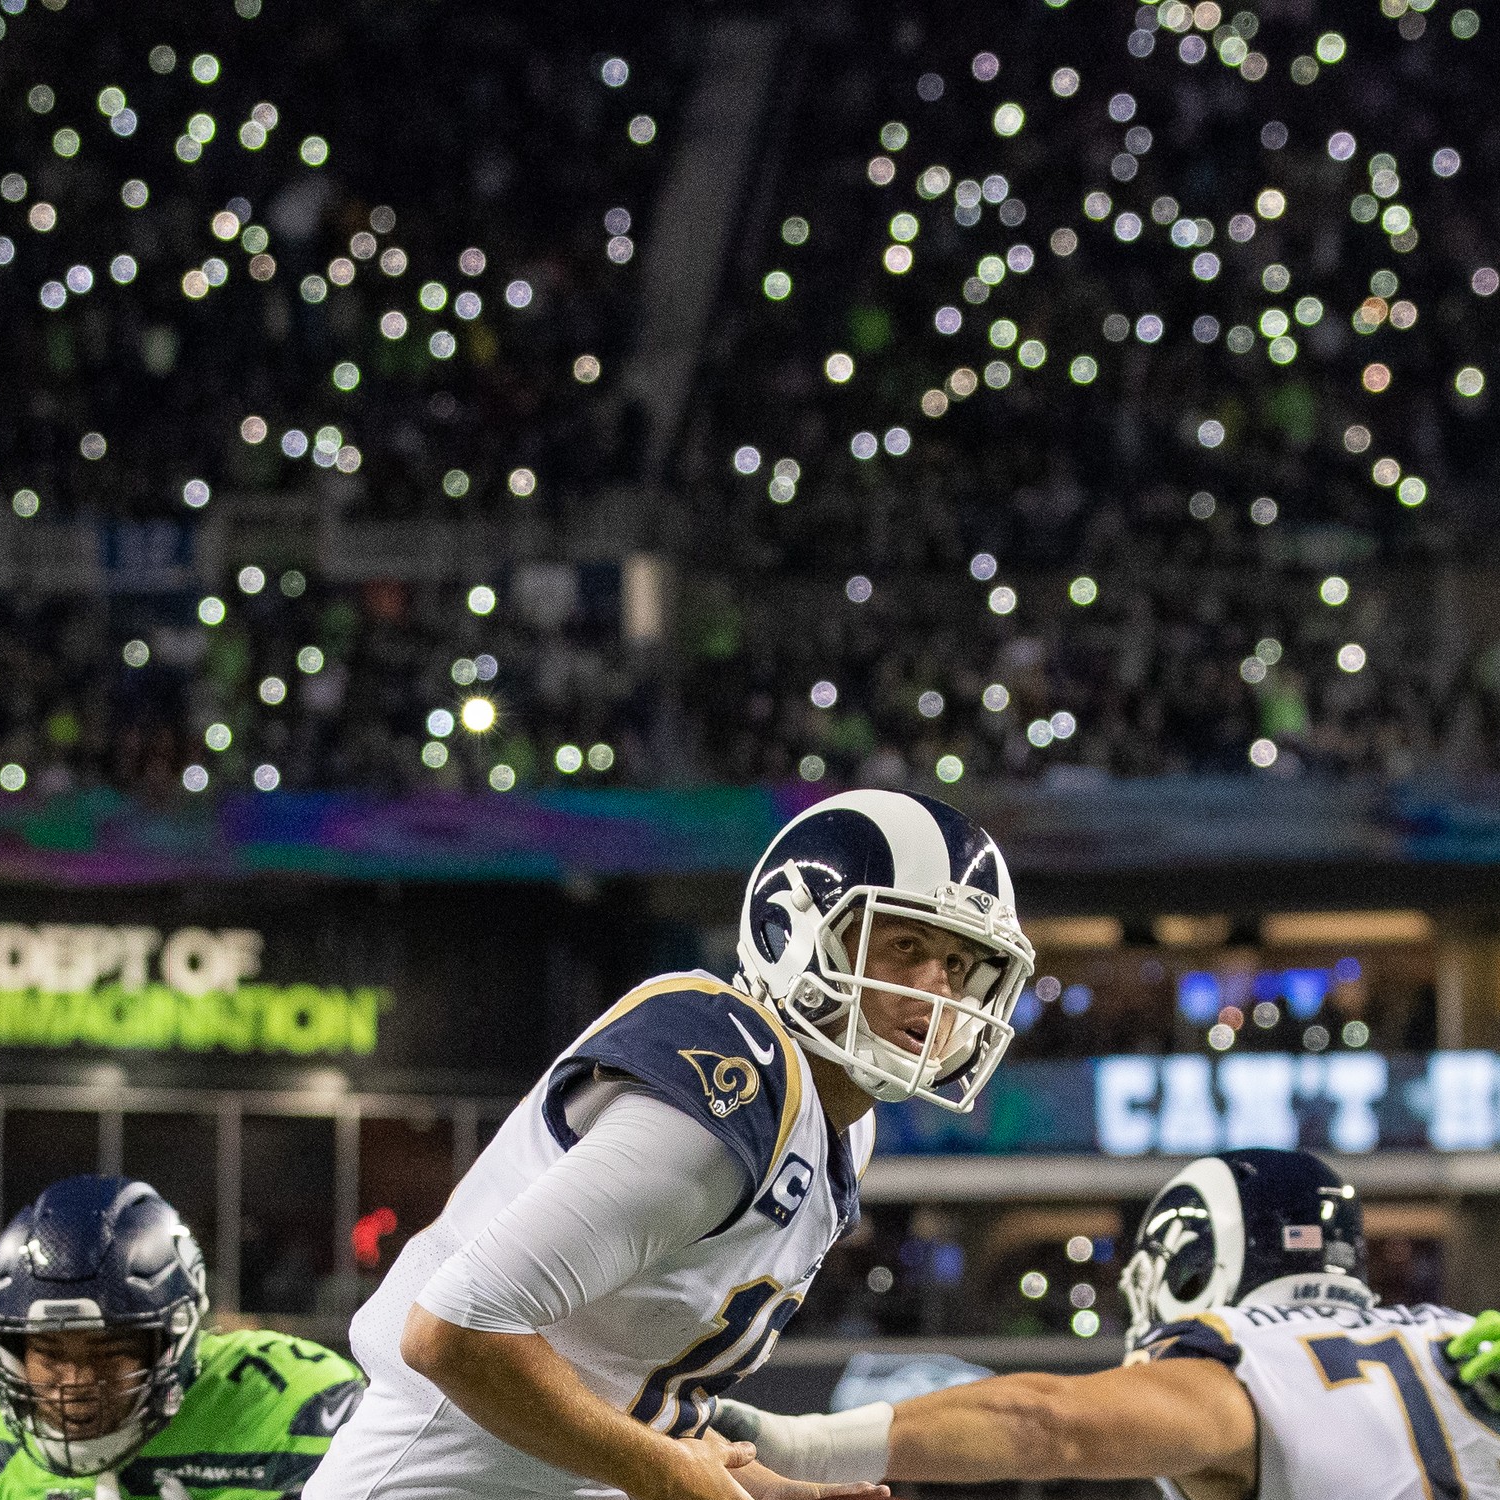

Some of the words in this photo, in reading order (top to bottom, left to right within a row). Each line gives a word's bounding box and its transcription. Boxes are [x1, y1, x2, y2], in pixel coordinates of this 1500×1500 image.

[161, 926, 265, 996] OF
[1097, 1050, 1389, 1156] CAN'T
[772, 1160, 812, 1212] C
